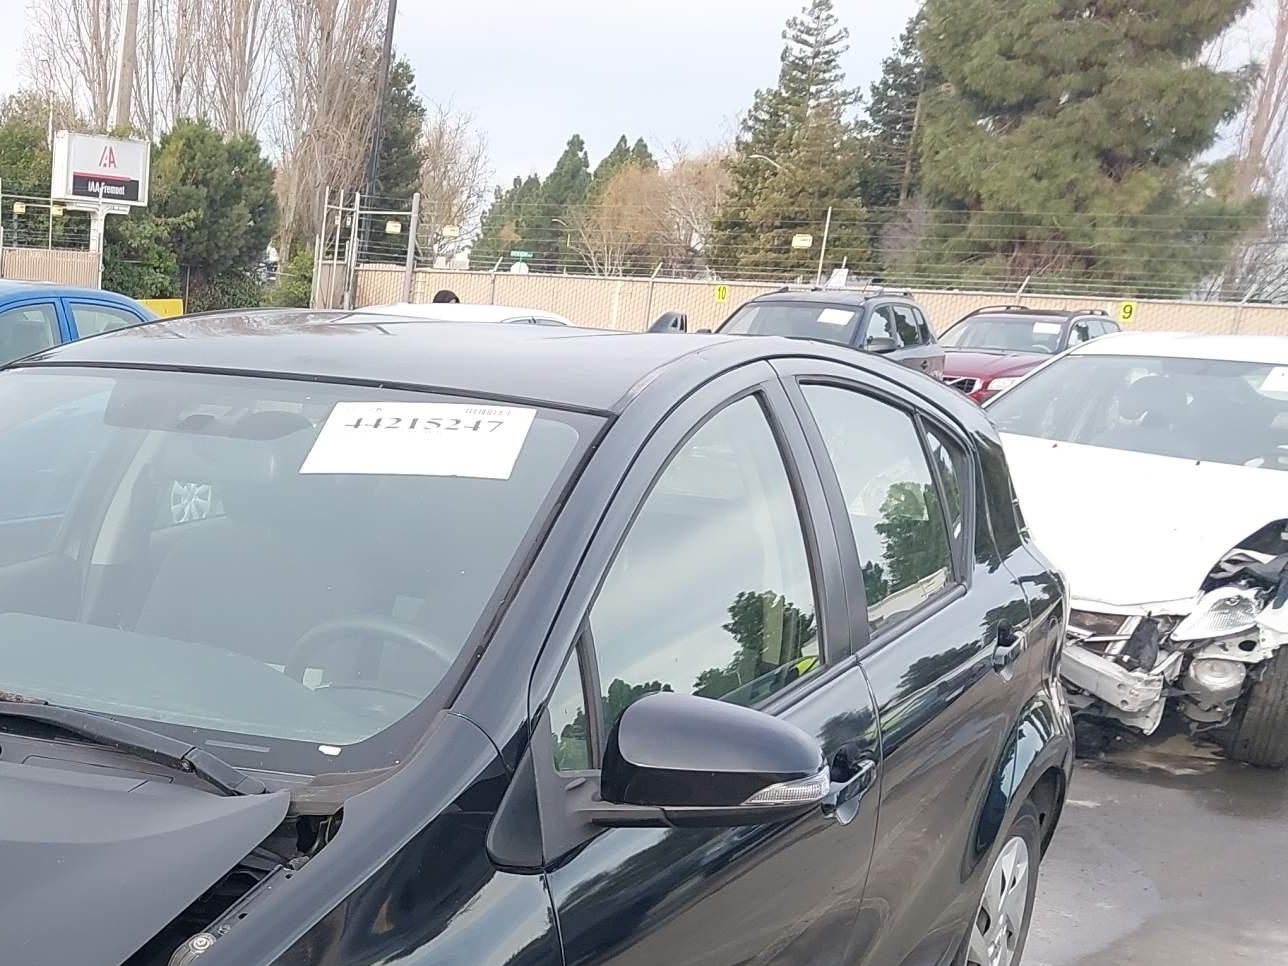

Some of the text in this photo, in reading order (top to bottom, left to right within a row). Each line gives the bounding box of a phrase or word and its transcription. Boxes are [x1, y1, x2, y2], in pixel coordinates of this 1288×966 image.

[101, 182, 125, 196] Fremont
[718, 285, 727, 300] 10
[1122, 304, 1133, 320] 9
[344, 416, 505, 433] 44215247
